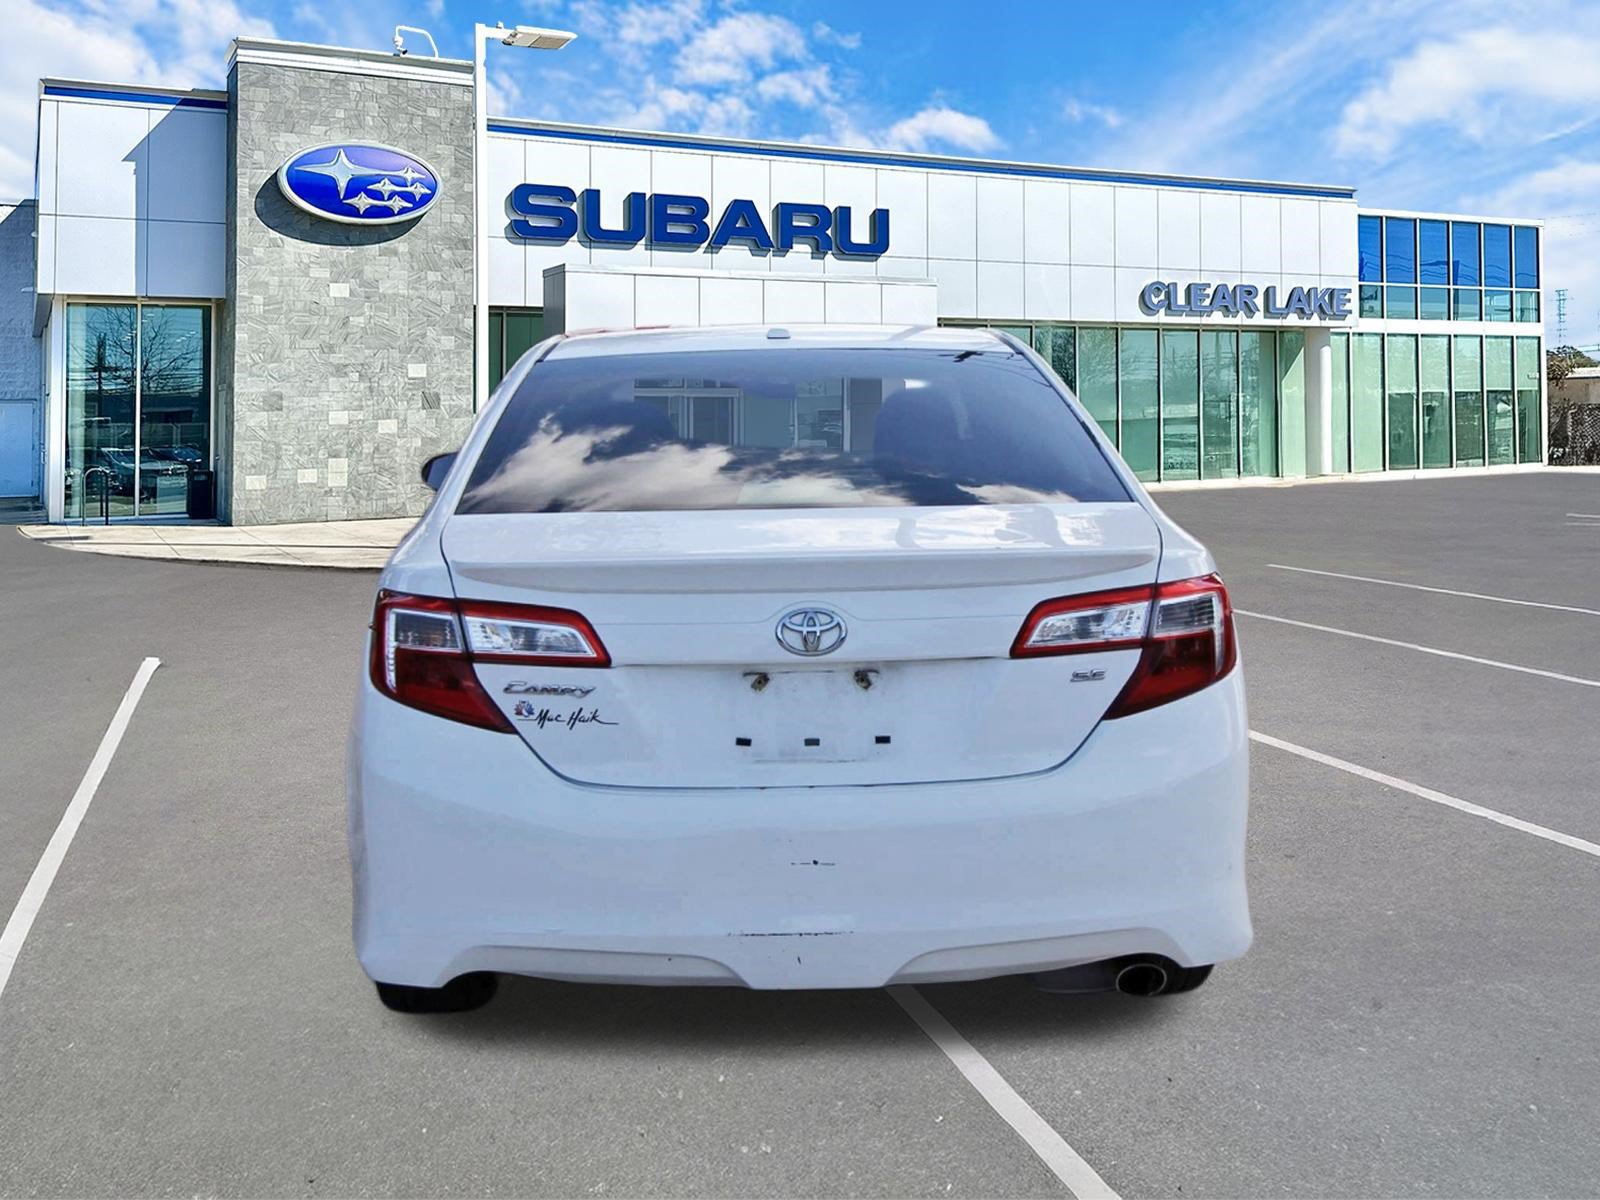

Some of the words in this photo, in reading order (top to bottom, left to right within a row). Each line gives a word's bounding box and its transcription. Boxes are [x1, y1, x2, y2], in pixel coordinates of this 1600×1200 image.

[505, 183, 890, 261] SUBARU
[1139, 281, 1260, 318] CLEAR
[1264, 285, 1353, 320] LAKE
[1070, 669, 1105, 682] SE
[517, 708, 566, 729] Mac
[566, 706, 619, 730] Haik
